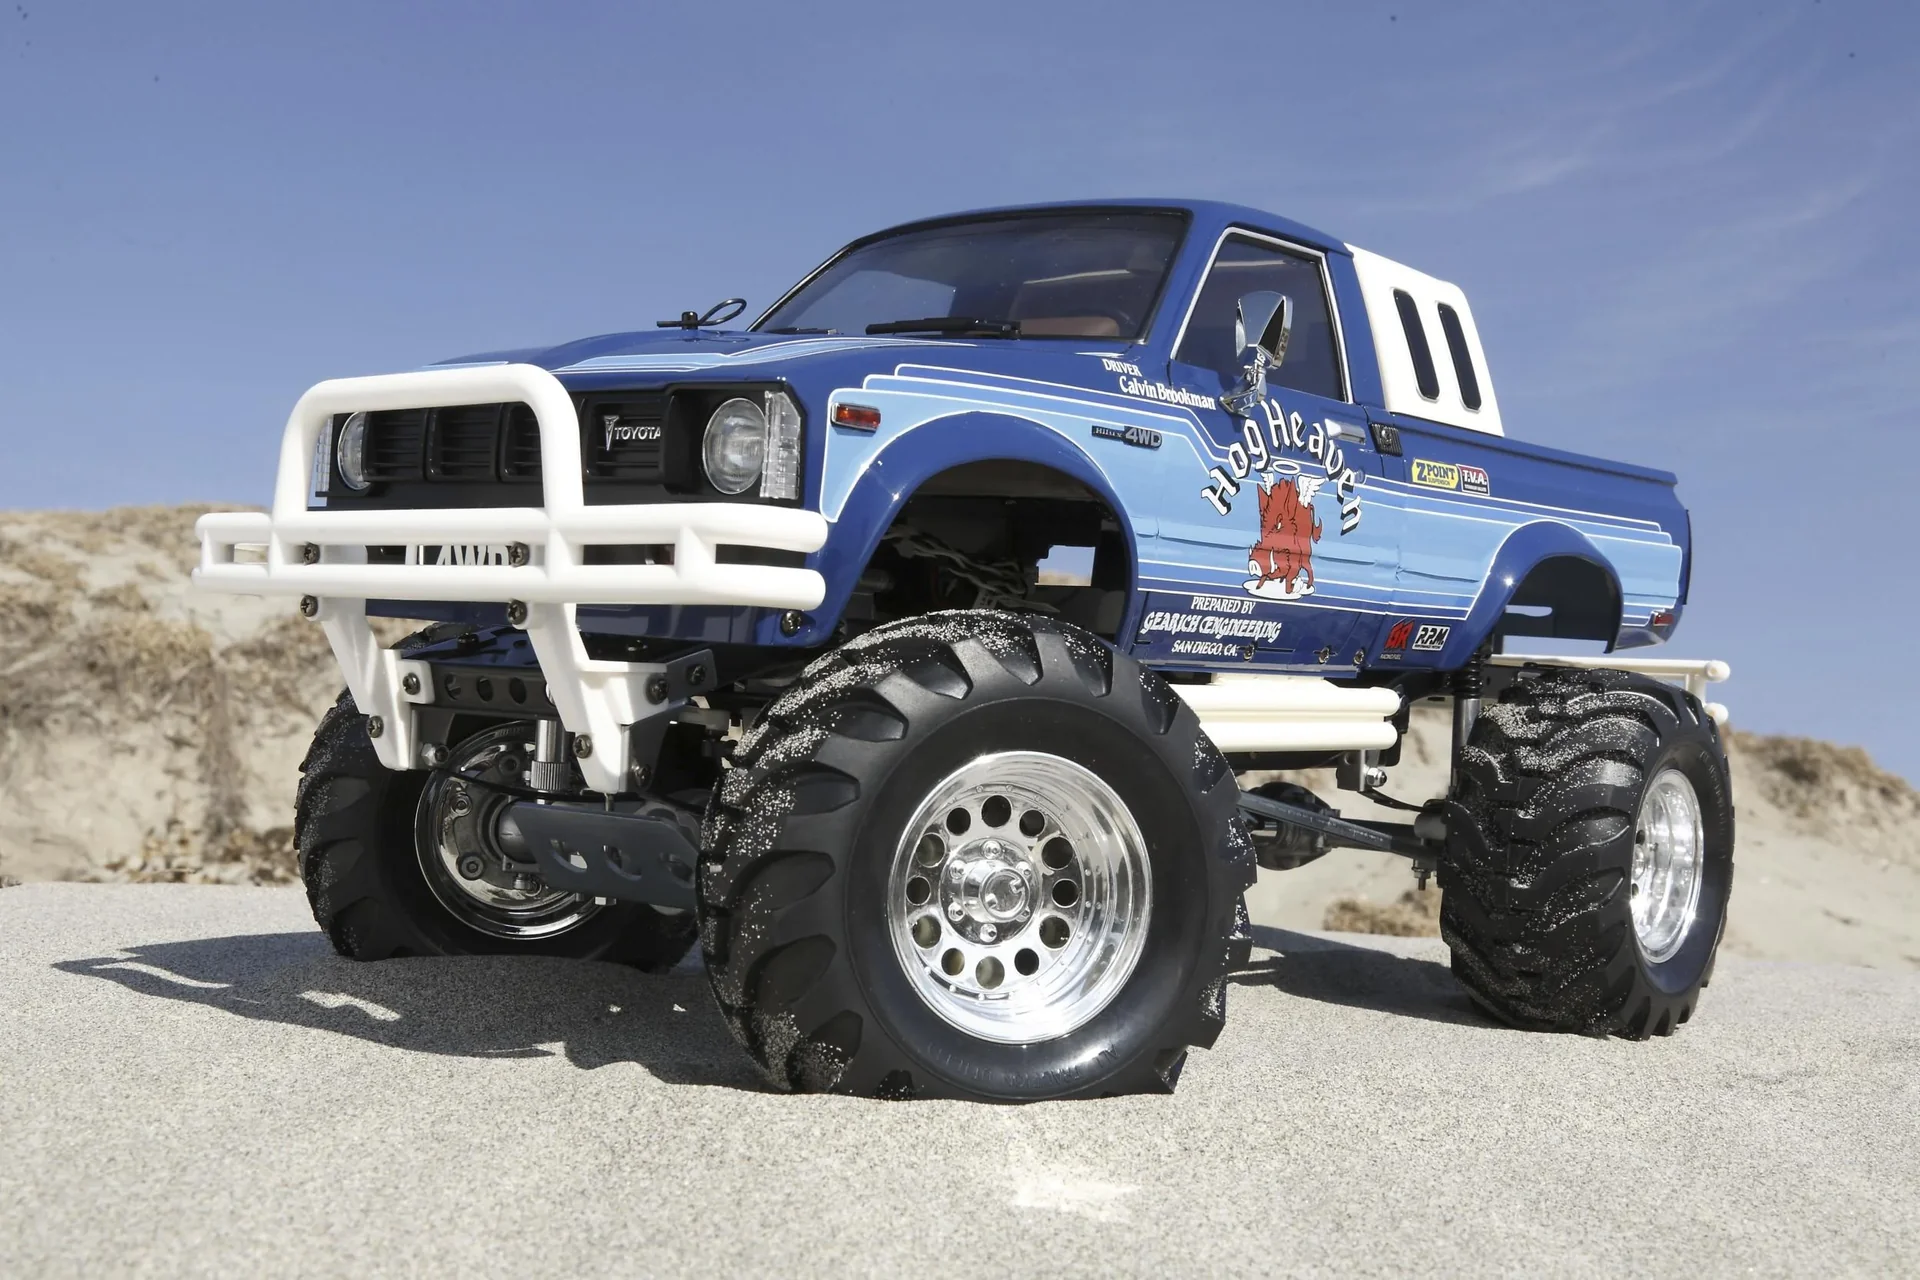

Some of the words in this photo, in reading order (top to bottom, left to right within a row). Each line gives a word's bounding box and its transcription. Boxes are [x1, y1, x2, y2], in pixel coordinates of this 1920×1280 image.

[1102, 358, 1142, 377] DRIVER
[1119, 376, 1157, 399] Calvin
[1156, 383, 1216, 410] Brookman
[614, 426, 661, 440] TOYOTA
[1125, 427, 1162, 447] 4WD
[1201, 419, 1271, 517] Hog
[1261, 399, 1362, 536] Heaven
[1416, 462, 1427, 481] Z
[1426, 464, 1455, 480] POINT
[1190, 596, 1241, 613] PREPARED
[1241, 601, 1256, 614] BY
[1140, 611, 1202, 635] GEARICH
[1199, 616, 1282, 643] ENGINEERING
[1171, 640, 1193, 653] SAN
